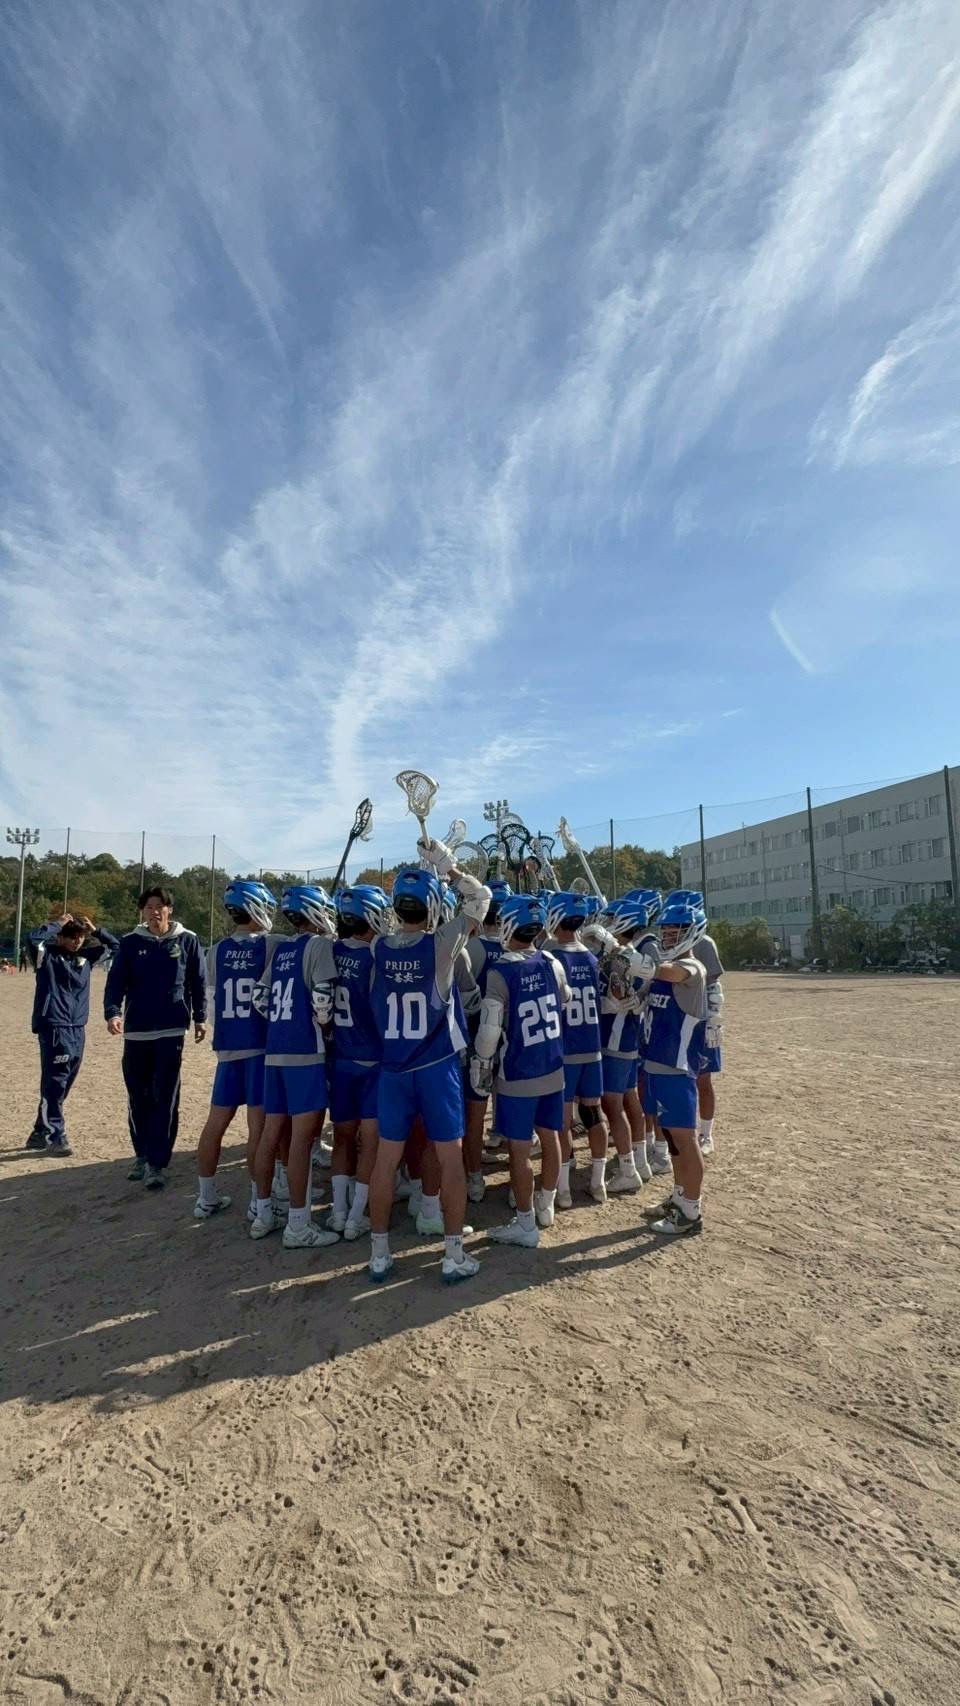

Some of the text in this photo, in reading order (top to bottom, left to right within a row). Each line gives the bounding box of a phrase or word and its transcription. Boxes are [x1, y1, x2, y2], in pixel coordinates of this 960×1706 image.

[225, 950, 253, 959] PRIDE
[384, 960, 421, 970] PRIDE
[221, 978, 257, 1019] 19
[520, 972, 542, 985] PRIDE
[269, 977, 295, 1022] 34
[384, 991, 428, 1040] 10
[517, 992, 561, 1048] 25
[565, 985, 599, 1027] 66
